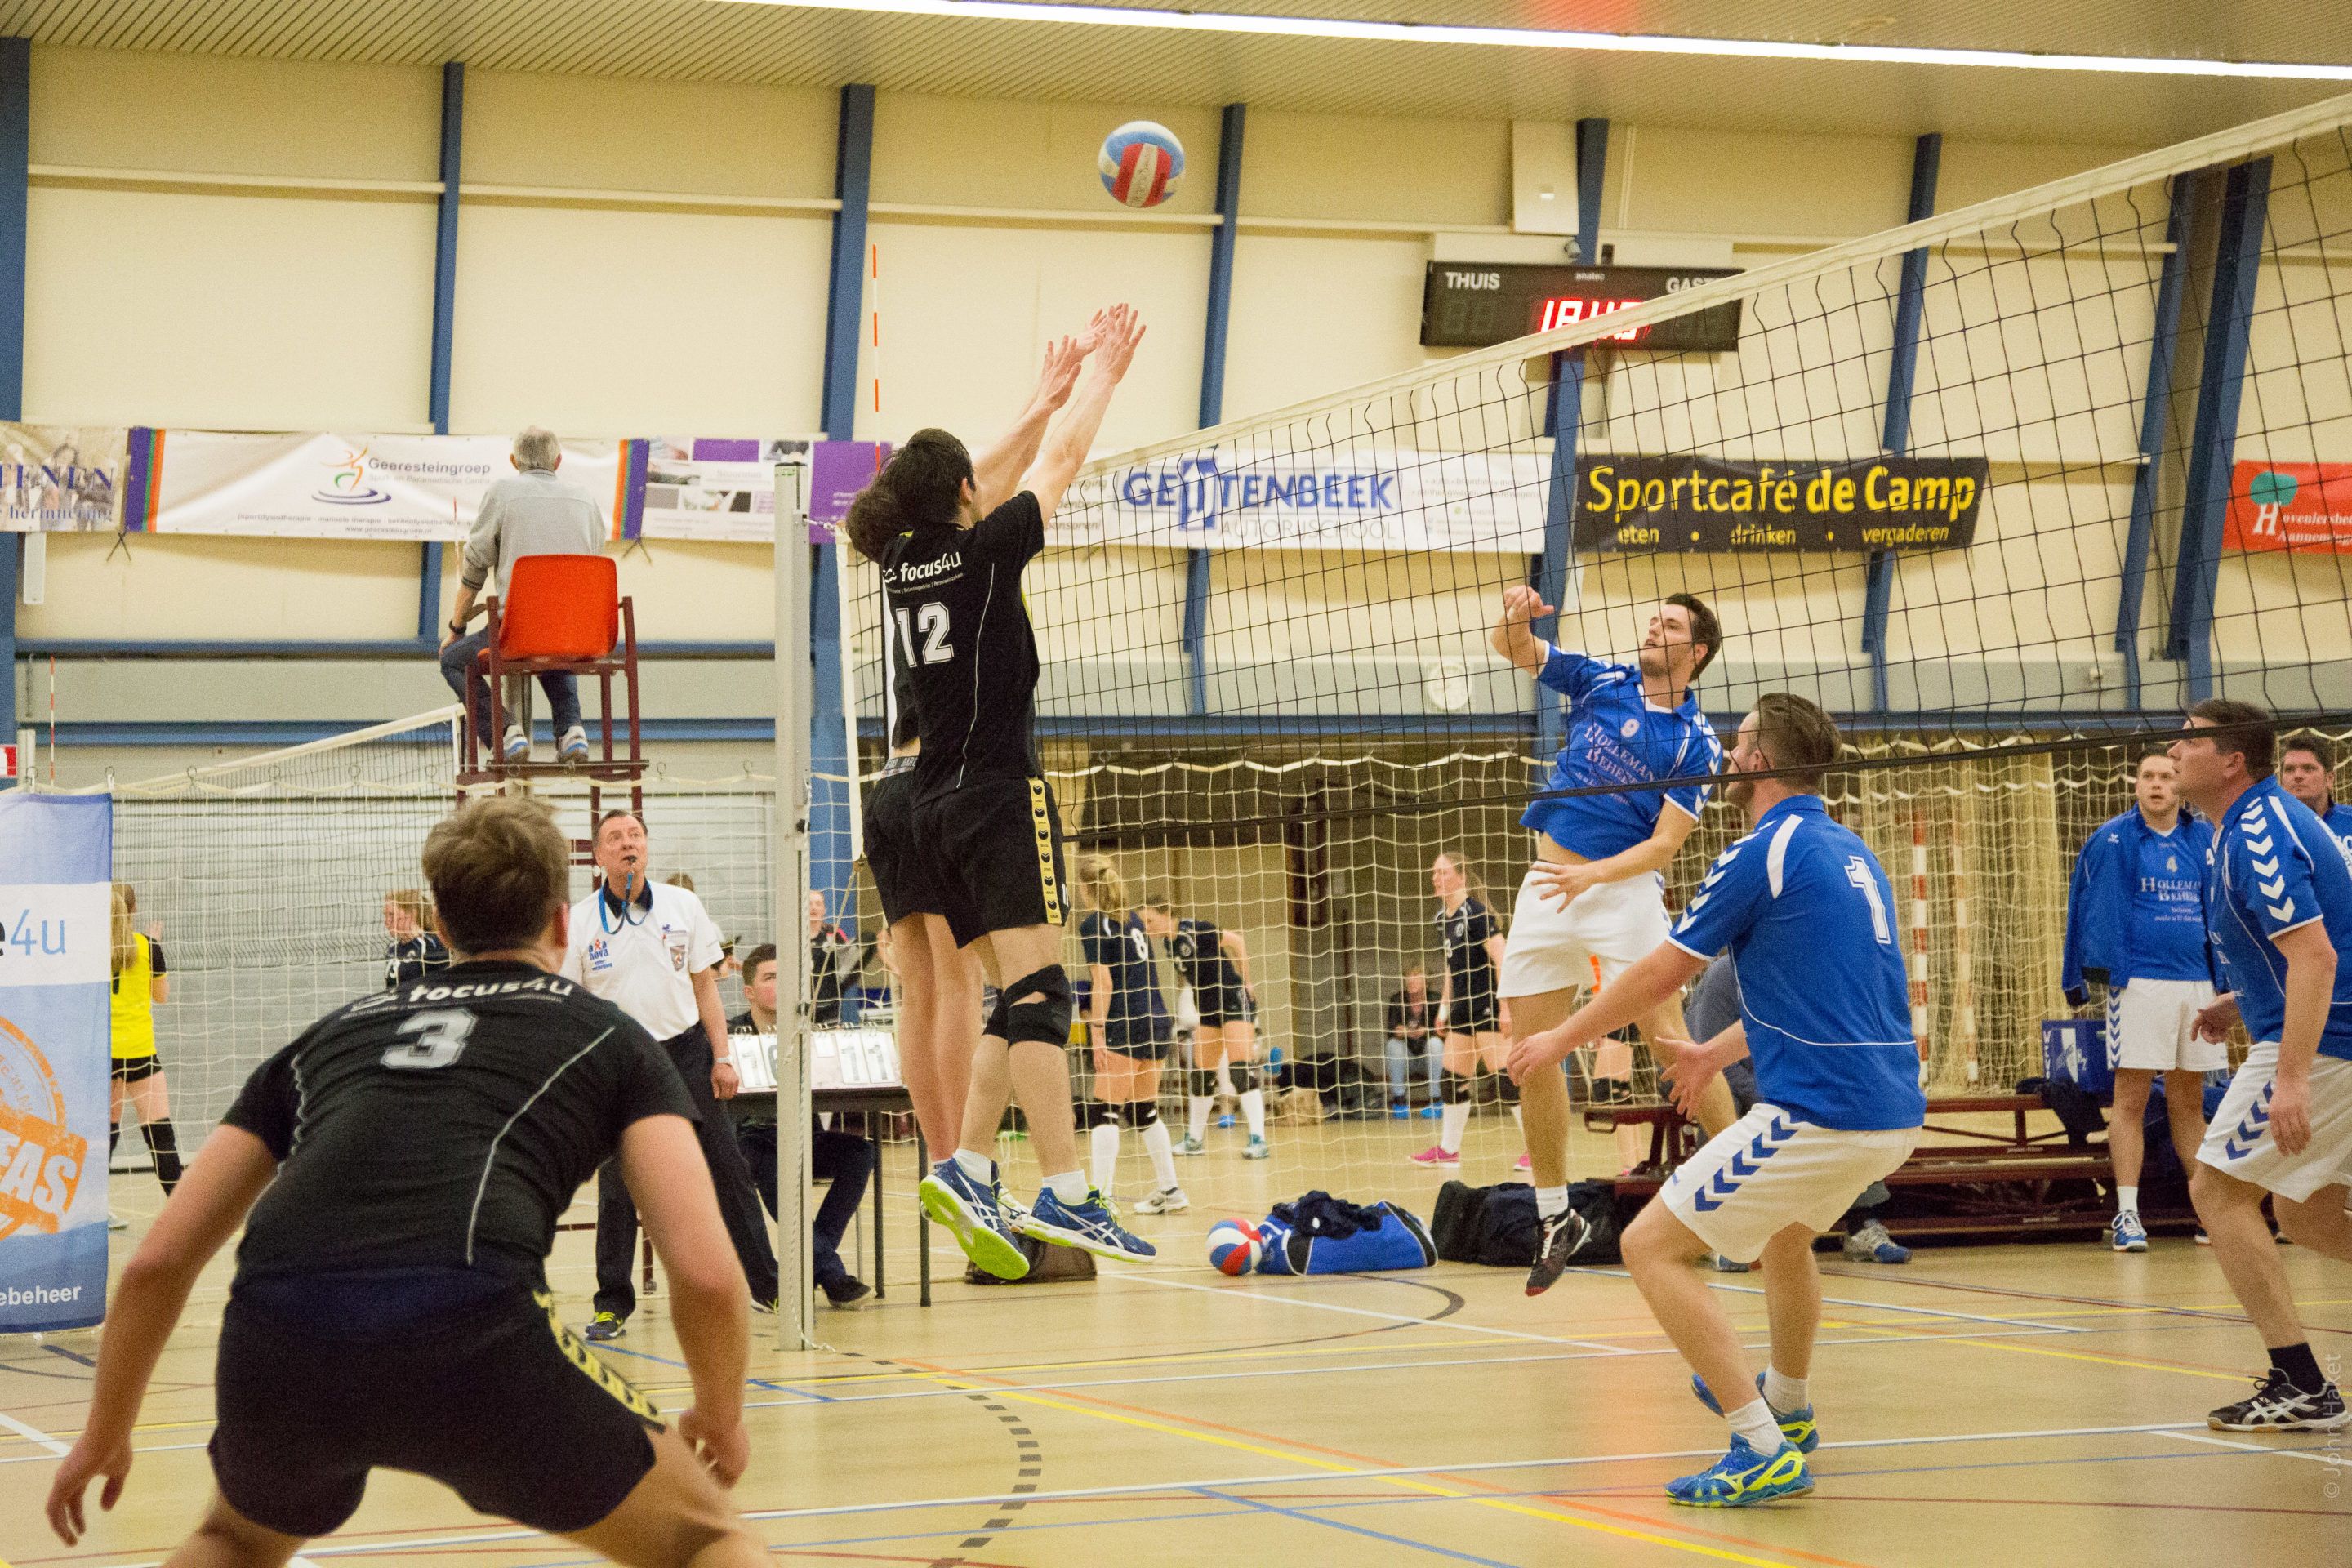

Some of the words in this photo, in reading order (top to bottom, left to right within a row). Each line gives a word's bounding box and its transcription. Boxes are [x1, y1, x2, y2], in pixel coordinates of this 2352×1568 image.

[1446, 271, 1501, 291] THUIS
[368, 457, 491, 476] Geeresteingroep
[1586, 465, 1796, 523] Sportcafé
[1806, 468, 1855, 514] de
[1864, 466, 1976, 522] Camp
[1618, 525, 1659, 544] eten
[1731, 523, 1796, 546] drinken
[1861, 525, 1949, 546] vergaderen
[900, 551, 962, 582] focus4u
[895, 601, 955, 668] 12
[1620, 718, 1641, 738] 9
[1843, 854, 1891, 945] 1
[0, 908, 66, 957] 4u
[1130, 928, 1148, 961] 8
[409, 976, 574, 1003] focus4u
[379, 1007, 479, 1070] 3
